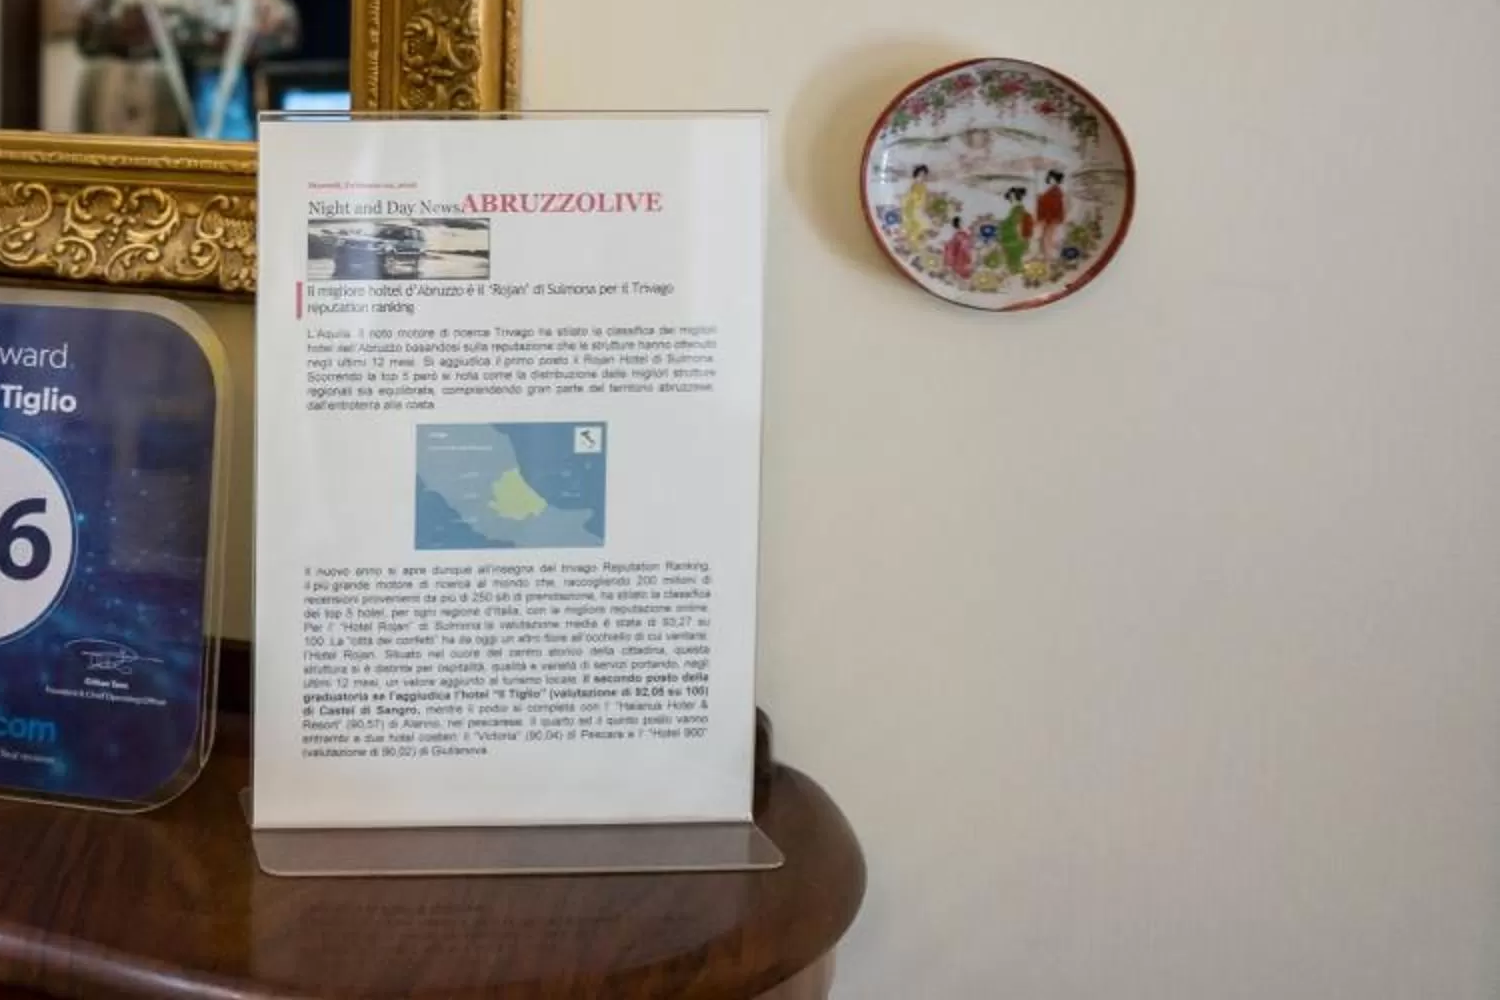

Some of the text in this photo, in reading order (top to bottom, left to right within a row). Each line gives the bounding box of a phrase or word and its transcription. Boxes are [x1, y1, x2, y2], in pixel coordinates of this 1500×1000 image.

[307, 200, 350, 217] Night
[354, 200, 383, 215] and
[387, 200, 415, 217] Day
[462, 192, 664, 213] ABRUZZOLIVE
[533, 283, 545, 295] di
[547, 283, 597, 295] Sulmona
[599, 284, 617, 297] per
[631, 281, 676, 297] Trivago
[371, 300, 415, 315] ranking
[1, 383, 77, 416] Tiglio
